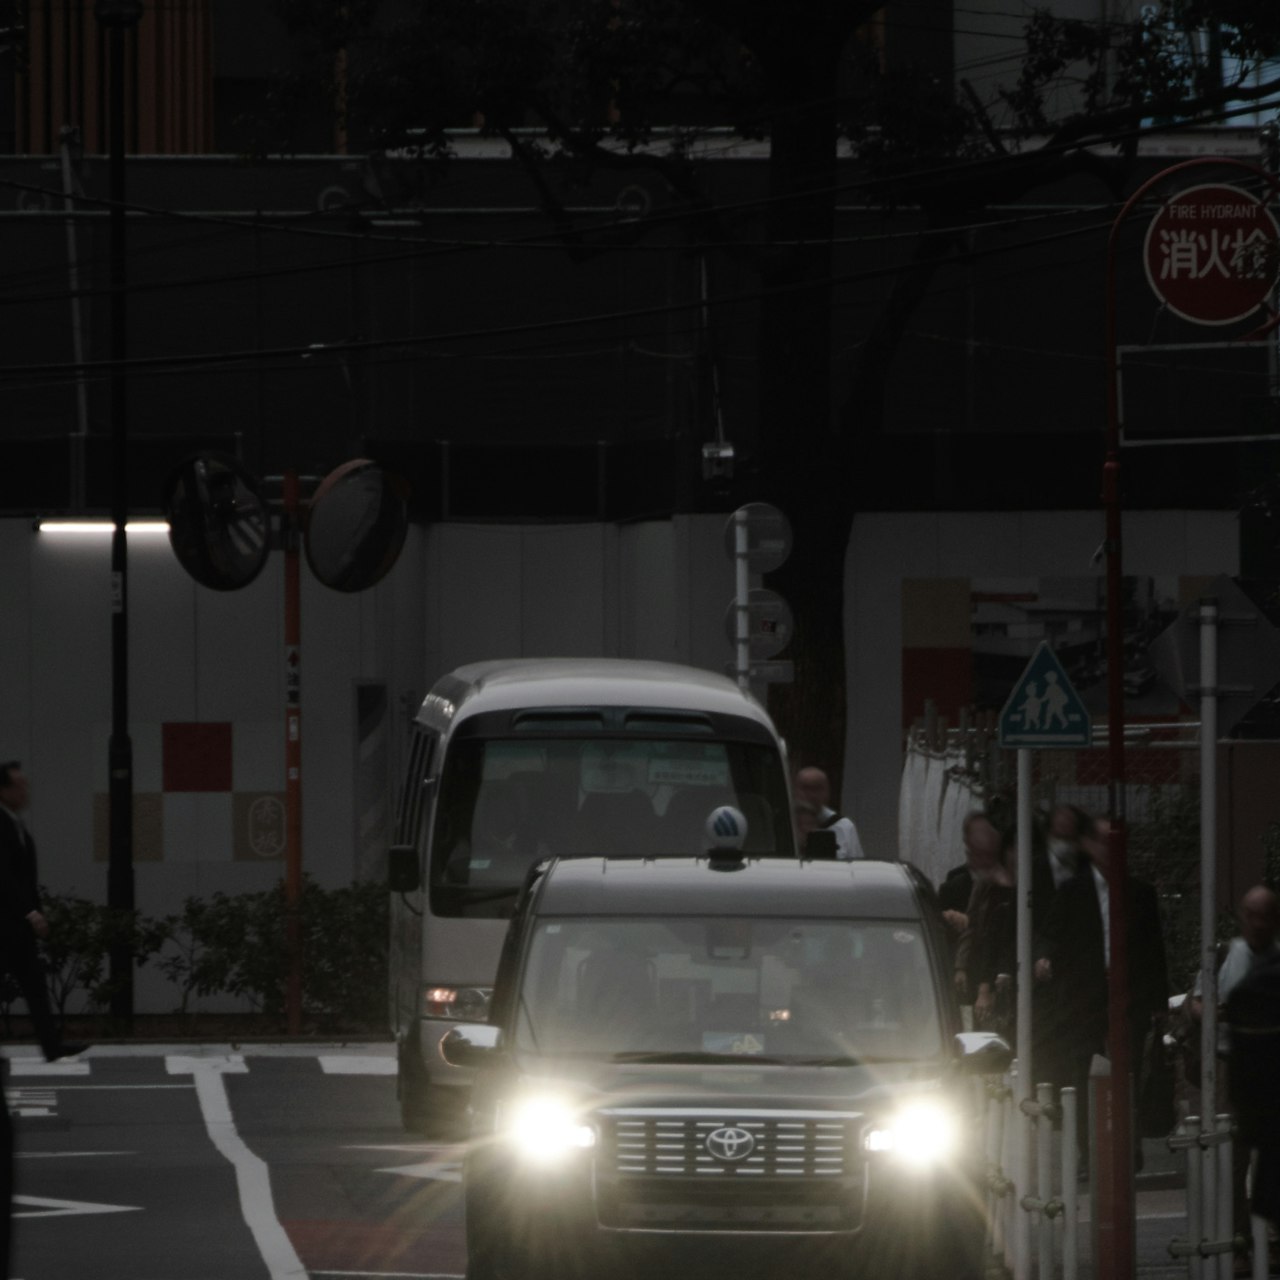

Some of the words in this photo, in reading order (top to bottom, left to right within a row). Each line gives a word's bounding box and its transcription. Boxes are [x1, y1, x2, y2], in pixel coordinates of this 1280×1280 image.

[1169, 204, 1198, 219] FIRE
[1200, 204, 1258, 219] HYDRANT
[1160, 228, 1269, 279] 消火栓
